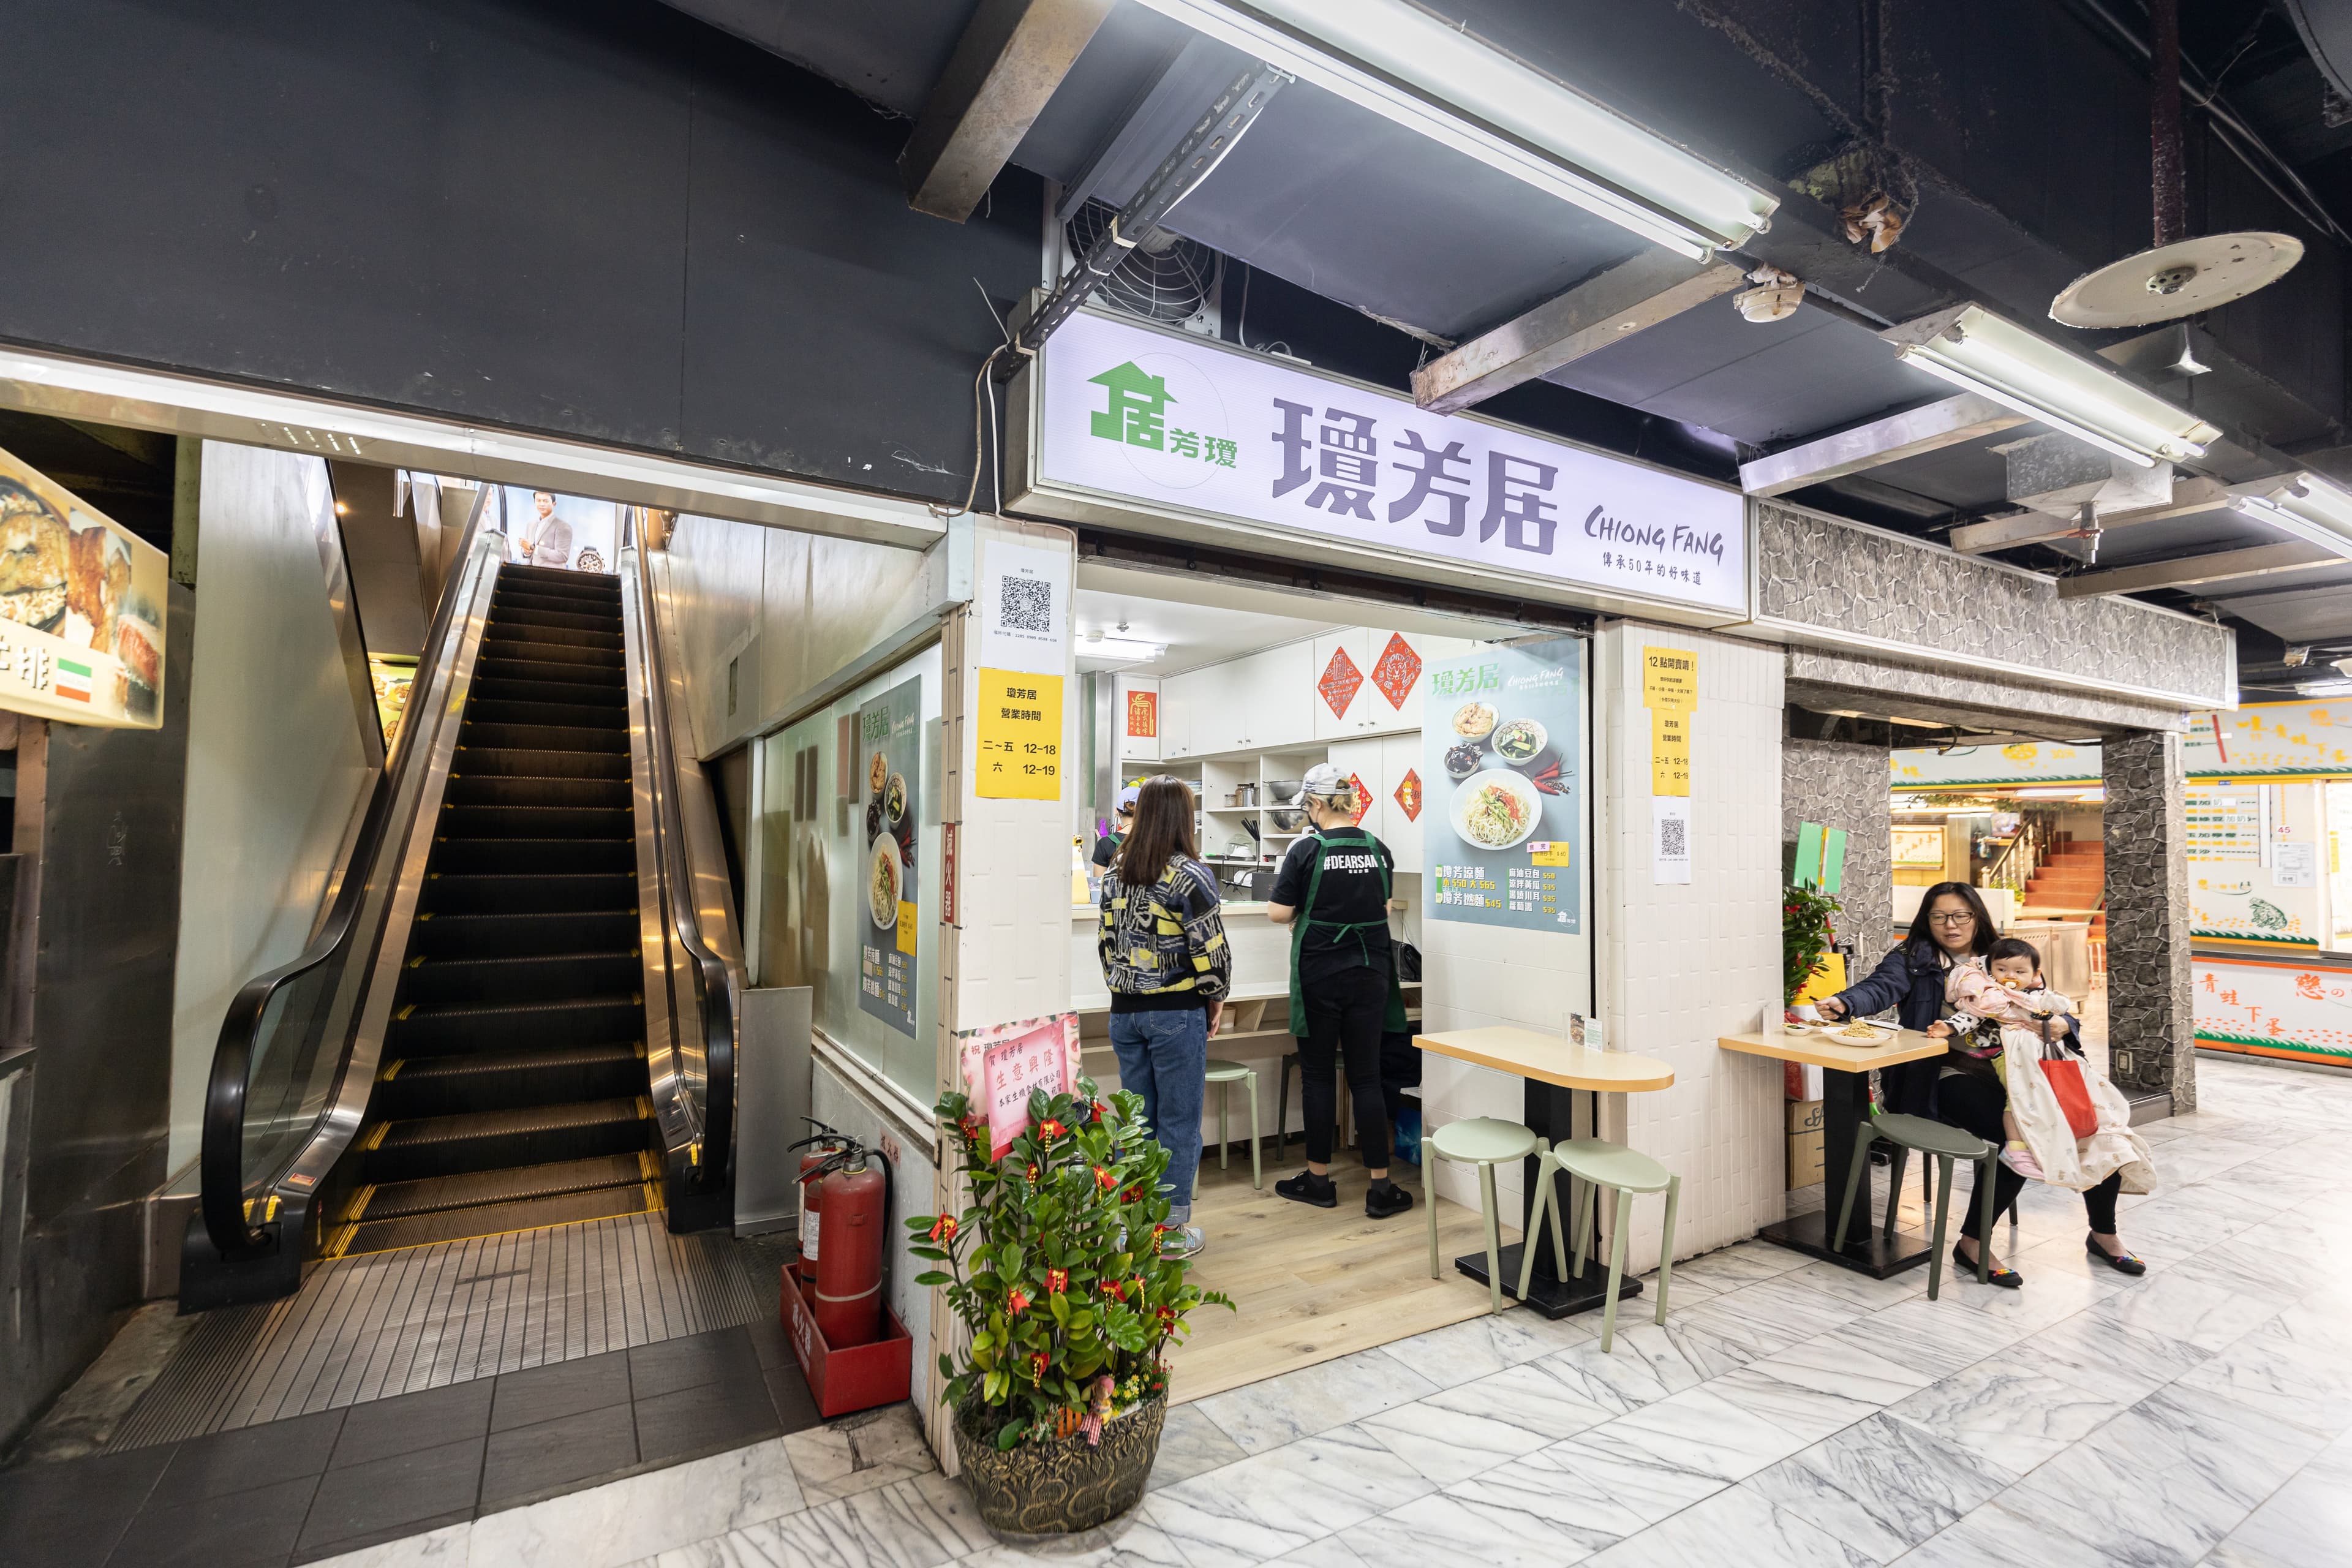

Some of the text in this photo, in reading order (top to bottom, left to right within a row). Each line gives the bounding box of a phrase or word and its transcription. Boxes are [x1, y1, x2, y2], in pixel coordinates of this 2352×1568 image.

[1272, 398, 1558, 555] 瓊芳居
[1585, 505, 1724, 567] CHIONG FANG
[1603, 552, 1701, 585] 傳承50年的好味道
[1649, 656, 1658, 667] 12
[1432, 663, 1499, 696] 瓊芳居
[1540, 667, 1564, 680] FANG
[1006, 687, 1037, 700] 瓊芳居
[1001, 707, 1041, 722] 營業時間
[1023, 743, 1056, 755] 12-18
[993, 761, 1055, 775] 六 12-19
[1442, 865, 1485, 880] 瓊芳涼麵
[1509, 868, 1540, 878] 麻油豆包
[1509, 879, 1540, 890] 涼拌黃瓜
[971, 1045, 981, 1055] 祝
[997, 1049, 1054, 1091] 生意興隆
